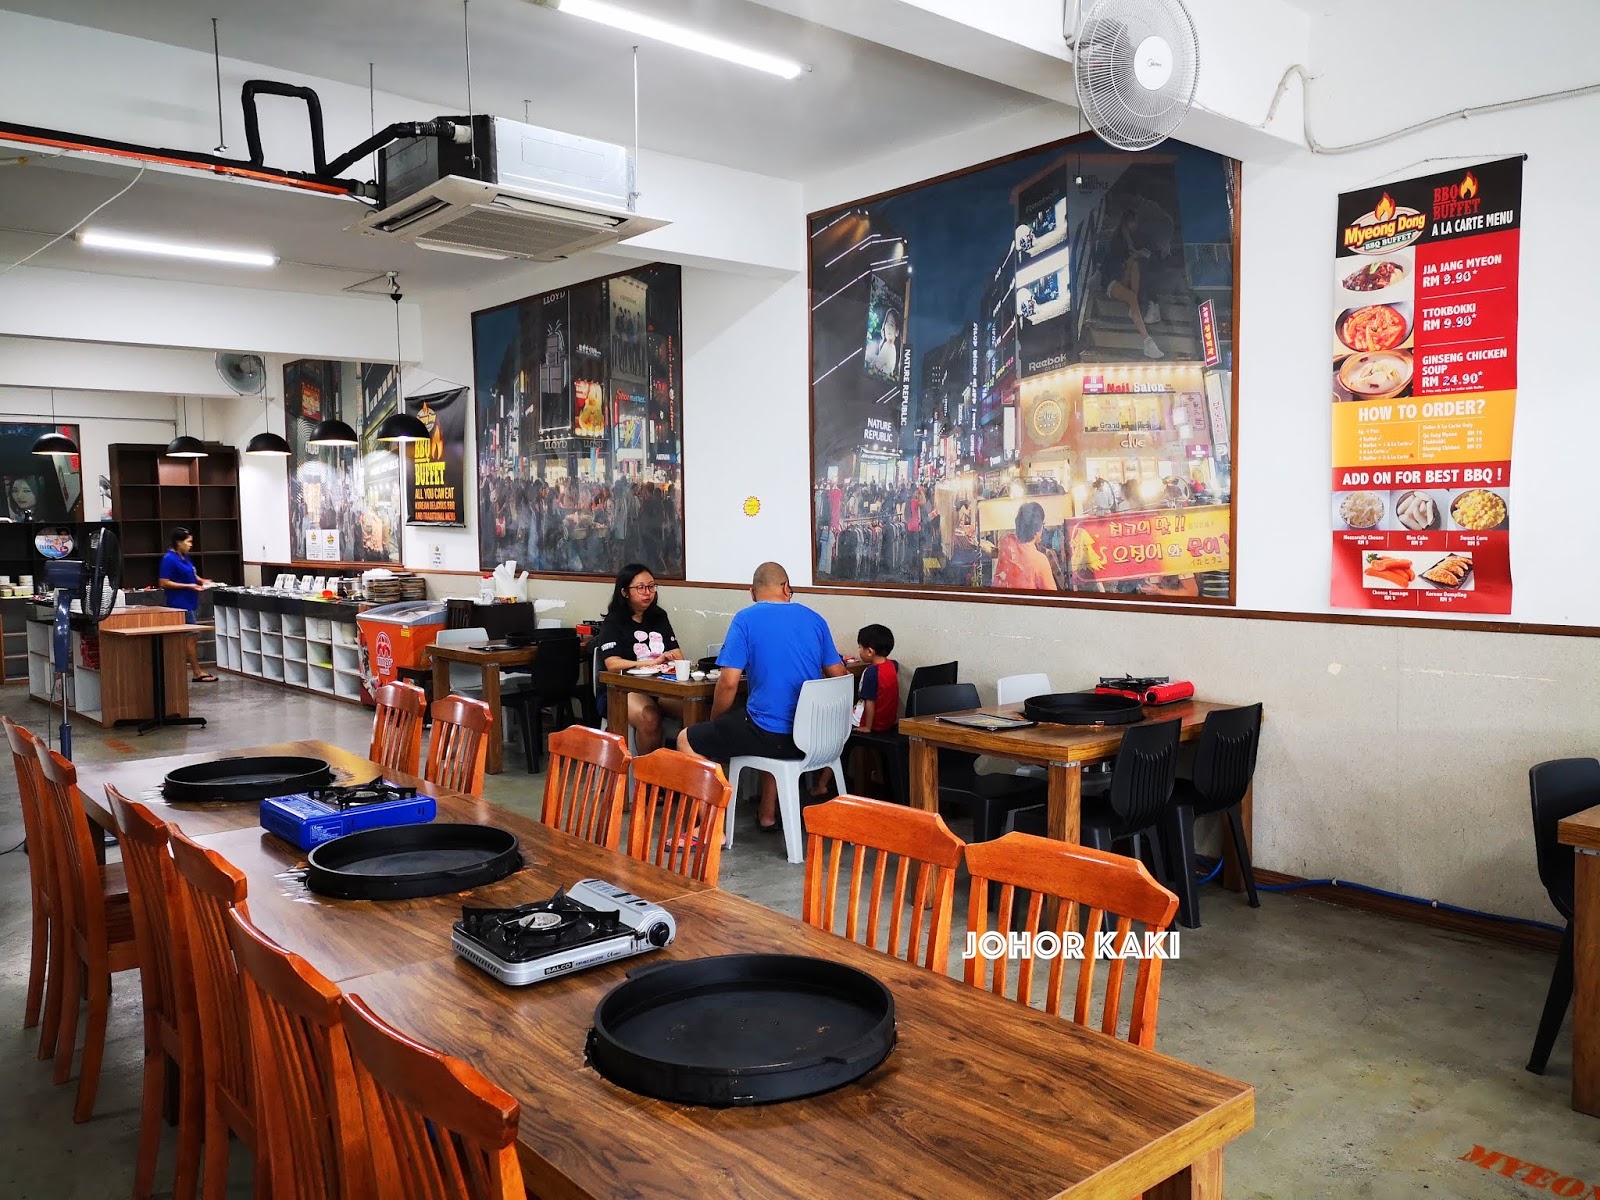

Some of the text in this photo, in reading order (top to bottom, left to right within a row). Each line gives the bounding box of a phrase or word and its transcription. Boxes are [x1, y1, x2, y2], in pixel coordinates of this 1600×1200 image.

[1434, 184, 1459, 202] BBQ
[1434, 198, 1480, 220] BUFFET
[1344, 214, 1426, 248] Myeong Dong
[1432, 210, 1514, 236] A LA CARTE MENU
[1365, 232, 1412, 250] BBQ BUFFET
[1423, 254, 1502, 275] JJA JANG MYEON
[1423, 275, 1440, 288] RM
[543, 291, 566, 305] LLOYD
[1422, 303, 1476, 318] TTOKBOKKI
[1423, 319, 1440, 331] RM
[1029, 353, 1067, 371] Reebok
[1422, 348, 1508, 365] GINSENG CHICKEN
[1422, 365, 1448, 375] SOUP
[901, 349, 911, 426] NATURE REPUBLIC
[1107, 383, 1130, 392] Nail
[1134, 383, 1165, 392] Salon
[1422, 376, 1438, 388] RM
[1359, 399, 1486, 422] HOW TO ORDER?
[868, 418, 892, 432] NATURE
[864, 429, 893, 442] REPUBLIC
[1120, 433, 1146, 448] clue
[415, 439, 430, 462] BBQ
[544, 440, 568, 449] LLOYD
[415, 462, 445, 486] BUFFET
[1342, 468, 1502, 485] ADD ON FOR BEST BBQ !
[415, 487, 454, 499] ALL YOU CAN EAT
[1112, 543, 1163, 564] 오징어
[1458, 1144, 1600, 1200] MYEO
